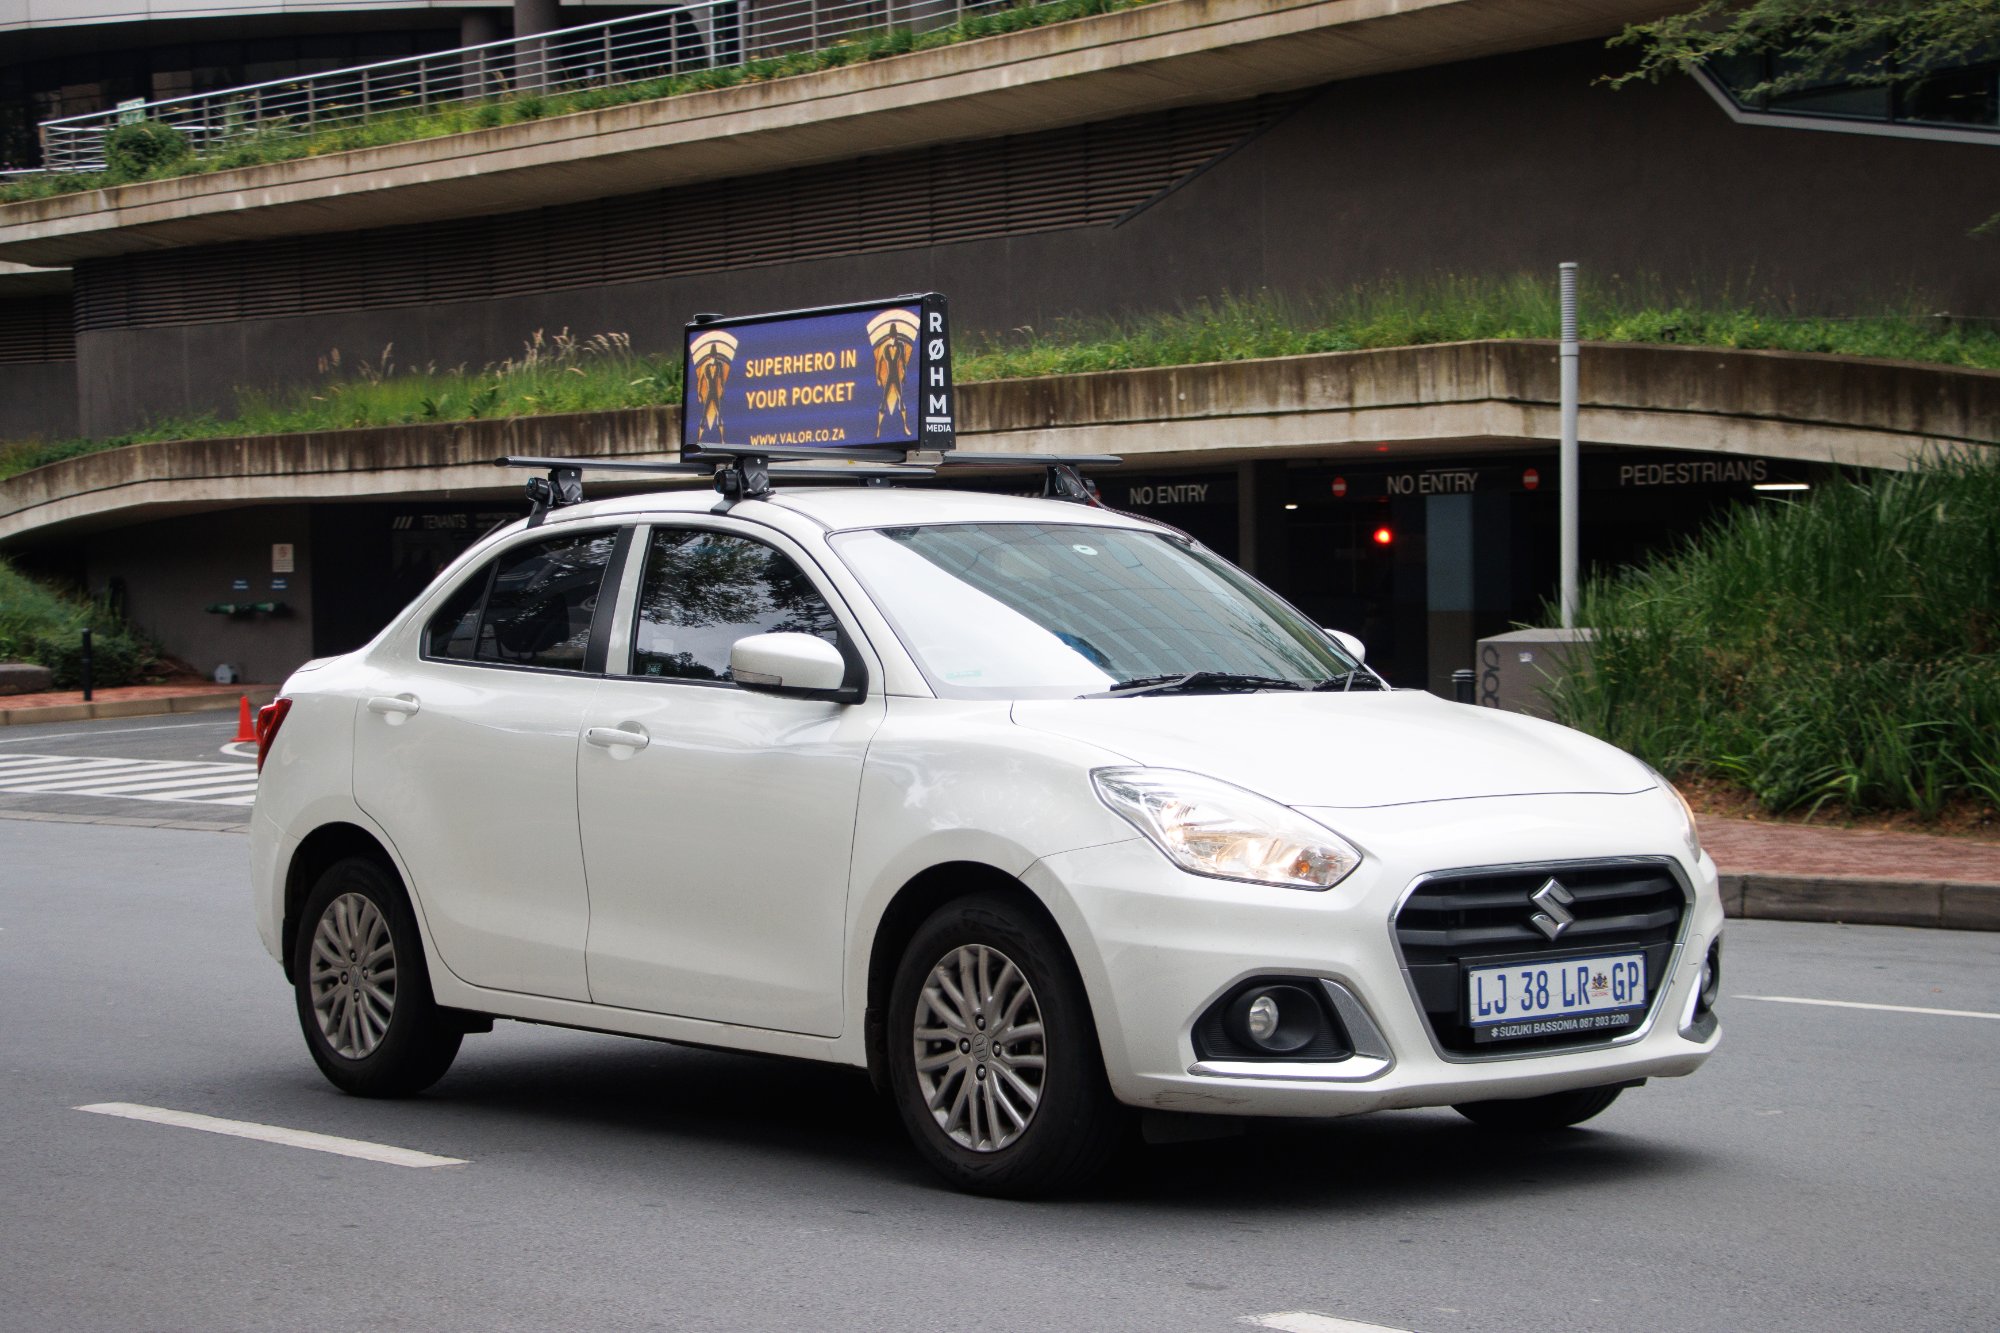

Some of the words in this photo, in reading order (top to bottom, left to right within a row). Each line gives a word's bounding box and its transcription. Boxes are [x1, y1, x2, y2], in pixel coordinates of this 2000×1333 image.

[745, 351, 835, 378] SUPERHERO
[840, 349, 857, 369] IN
[745, 388, 787, 410] YOUR
[791, 382, 855, 406] POCKET
[750, 428, 845, 446] WWW.VALOR.CO.ZA
[926, 423, 952, 433] MEDIA
[1387, 474, 1415, 495] NO
[1418, 472, 1479, 494] ENTRY
[1620, 459, 1768, 486] PEDESTRIANS
[1129, 485, 1154, 506] NO
[1157, 484, 1209, 504] ENTRY
[421, 513, 467, 529] TENANTS
[1477, 974, 1507, 1017] LJ
[1520, 970, 1550, 1011] 38
[1562, 966, 1590, 1008] LR
[1612, 961, 1639, 1003] GP
[1499, 1024, 1532, 1037] SUZUKI
[1533, 1020, 1579, 1034] BASSONIA
[1611, 1013, 1630, 1025] 2200
